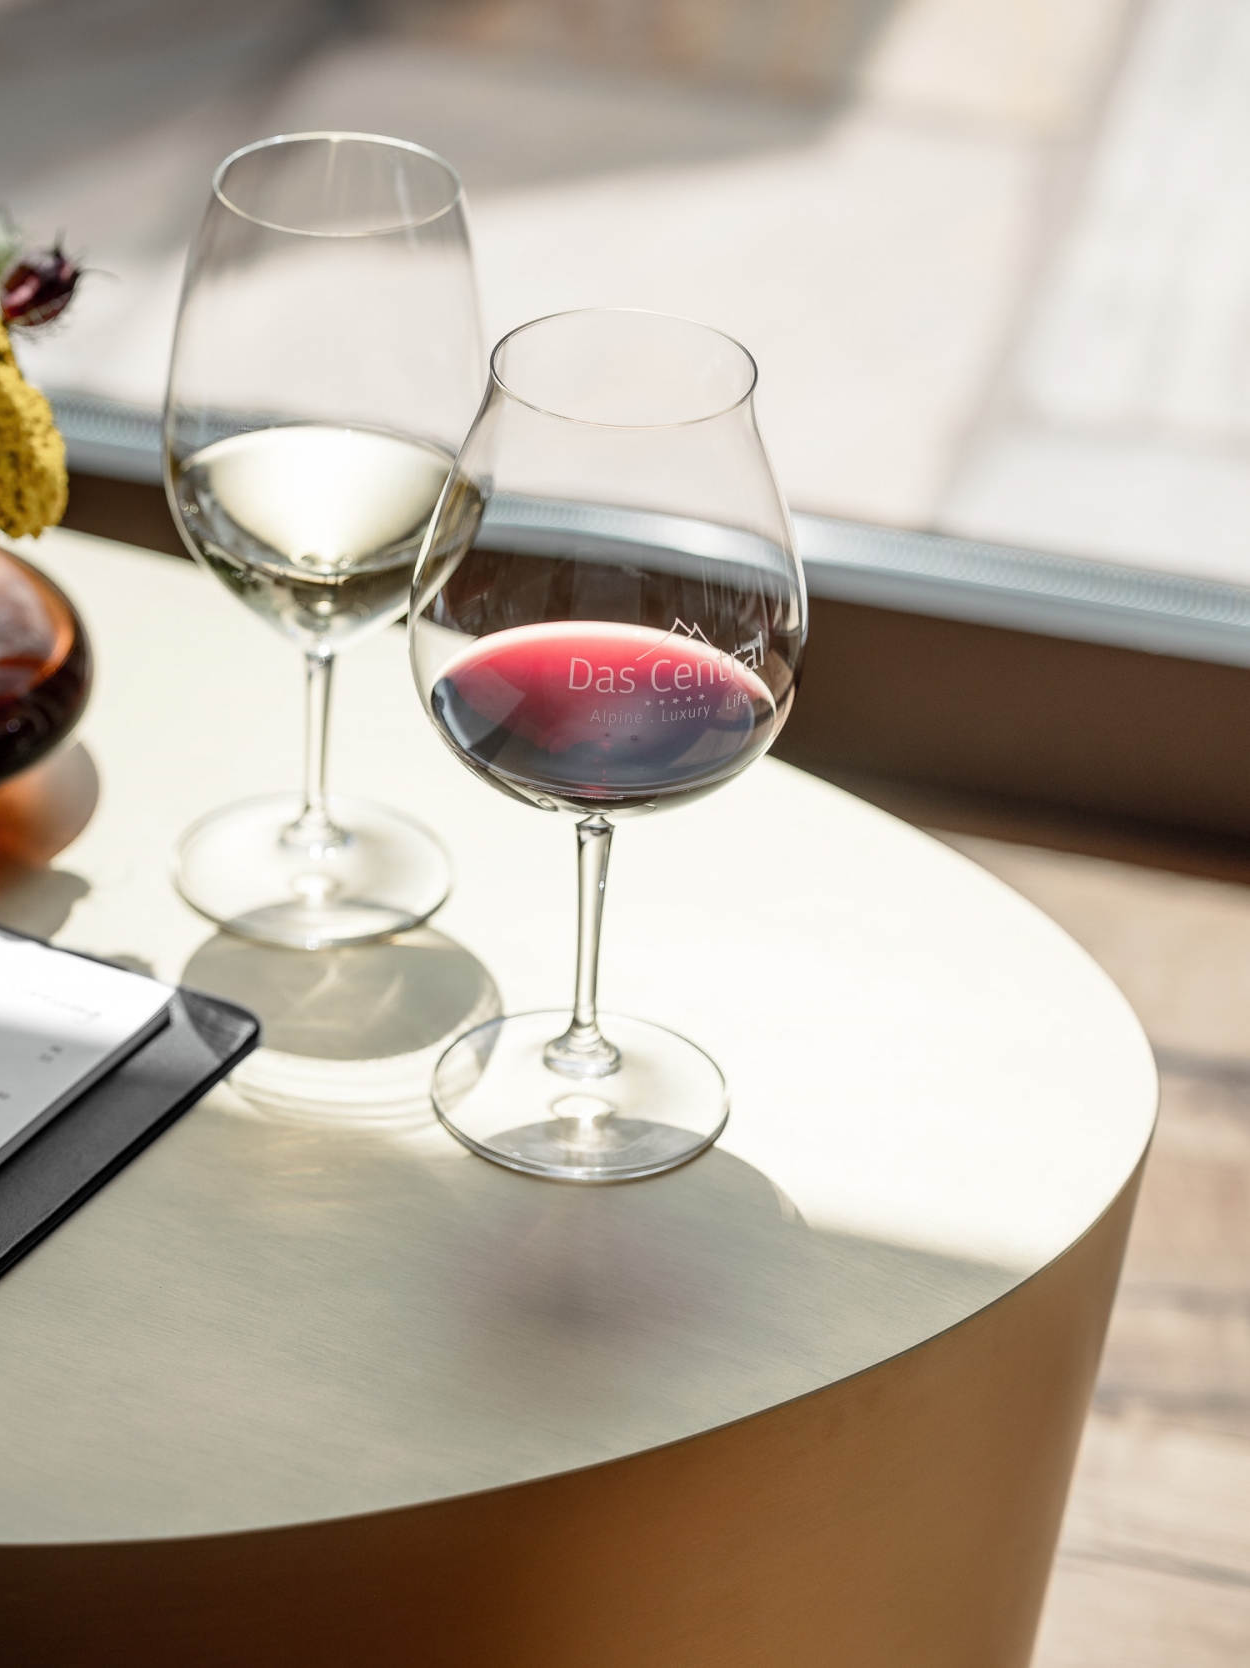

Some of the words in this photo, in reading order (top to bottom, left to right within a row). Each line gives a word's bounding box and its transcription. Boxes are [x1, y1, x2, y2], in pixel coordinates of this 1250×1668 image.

[568, 657, 635, 694] Das
[650, 630, 765, 693] Central
[589, 709, 643, 727] Alpine
[661, 704, 711, 722] Luxury
[726, 691, 749, 711] Life
